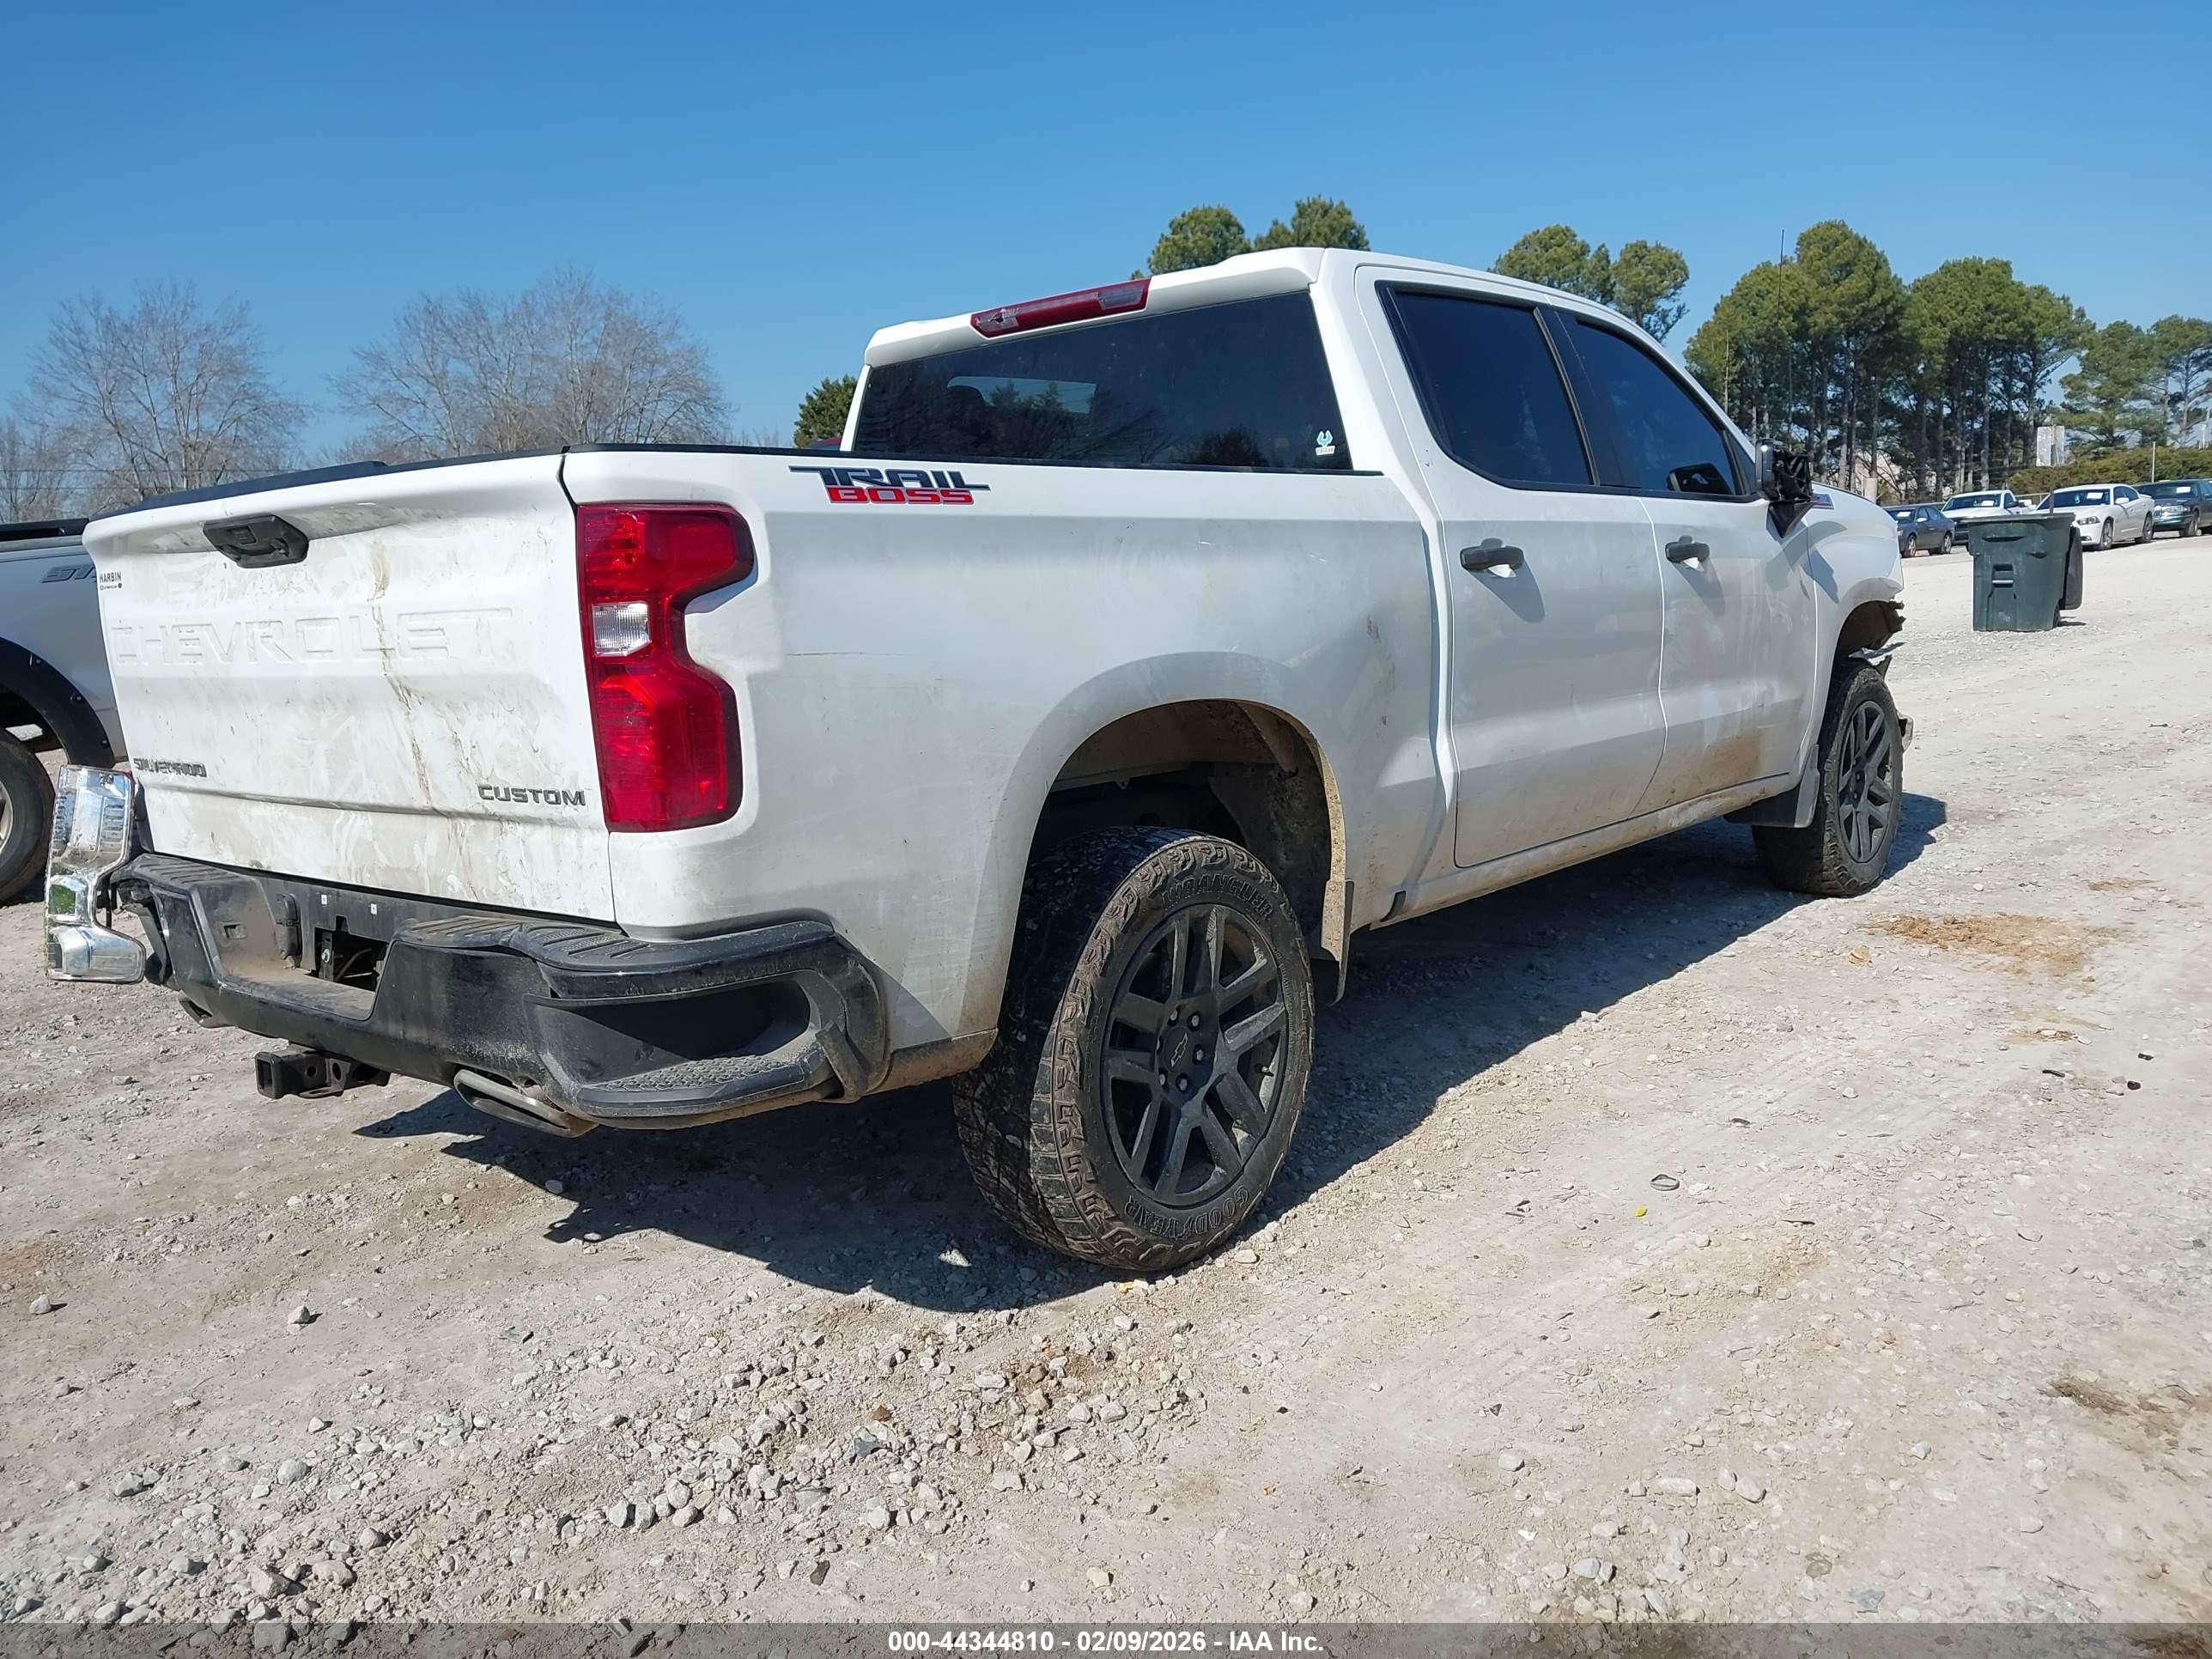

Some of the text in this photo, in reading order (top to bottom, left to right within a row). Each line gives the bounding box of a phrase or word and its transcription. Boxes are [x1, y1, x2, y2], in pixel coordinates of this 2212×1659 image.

[787, 465, 992, 491] TRAIL
[826, 486, 975, 505] BOSS
[100, 571, 122, 583] HARBIN
[112, 607, 513, 665] CHEVROLET
[477, 783, 586, 805] CUSTOM
[1161, 873, 1273, 921] WRANGLER
[1124, 1185, 1249, 1240] GOODYEAR
